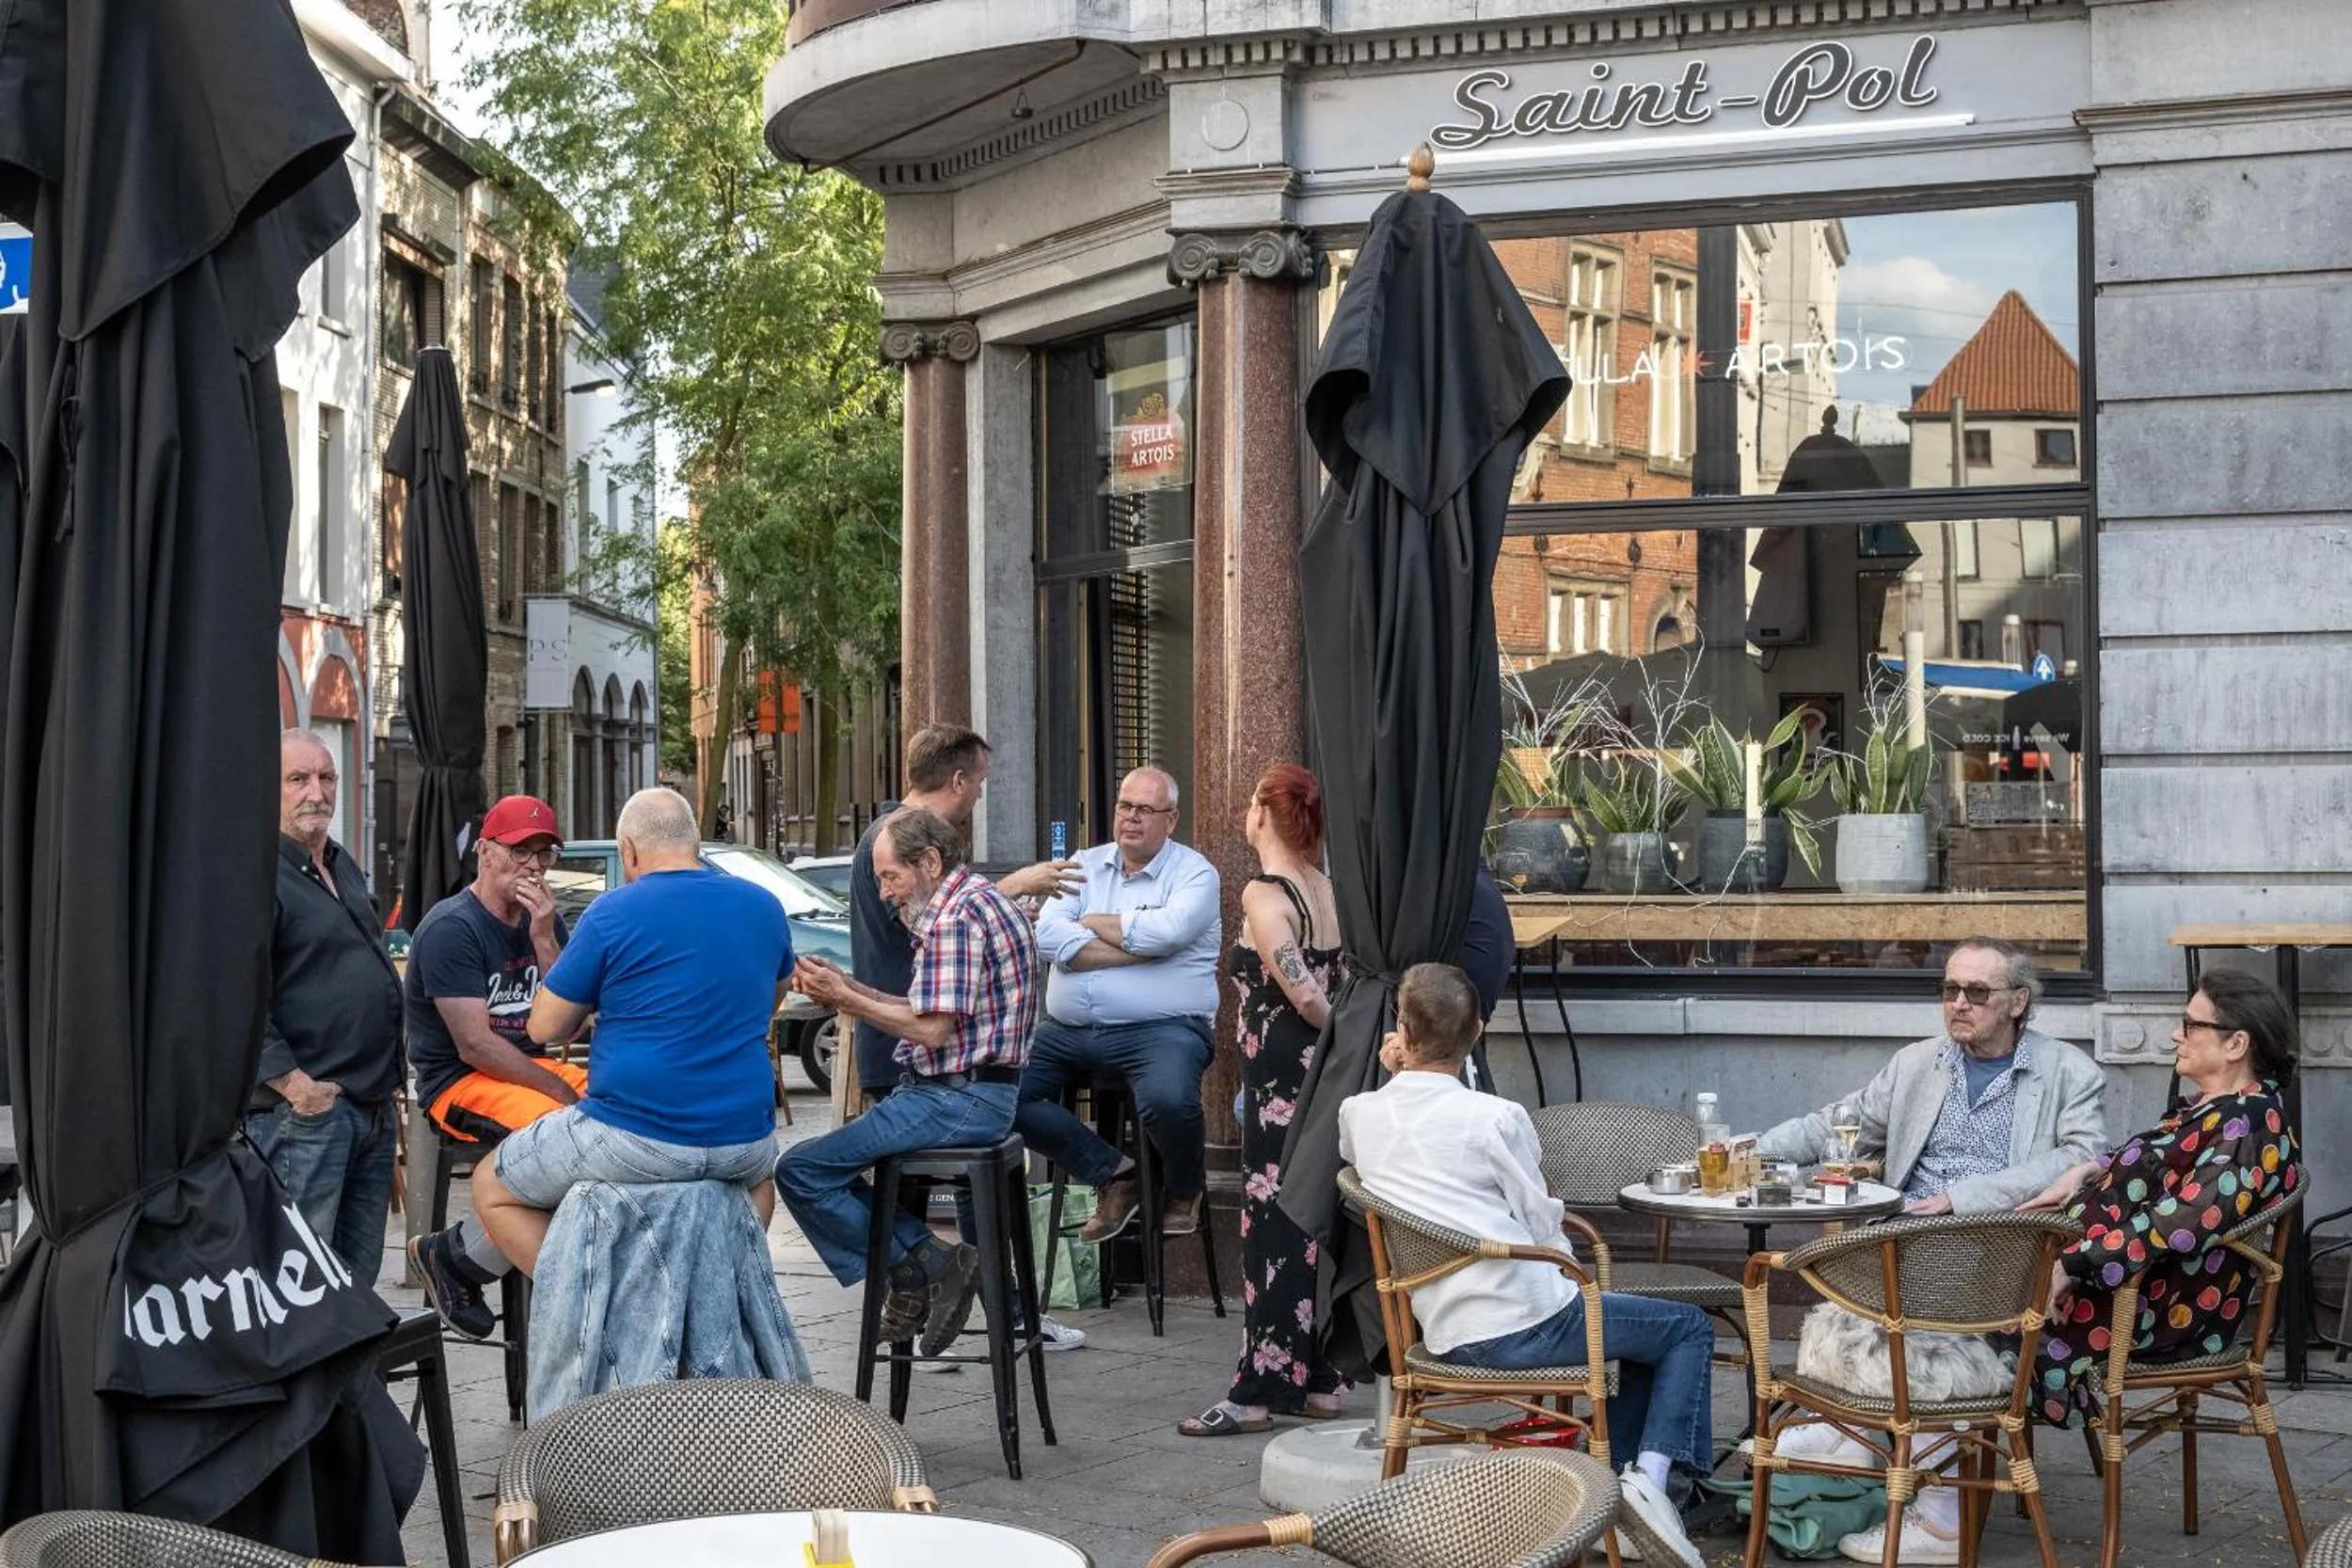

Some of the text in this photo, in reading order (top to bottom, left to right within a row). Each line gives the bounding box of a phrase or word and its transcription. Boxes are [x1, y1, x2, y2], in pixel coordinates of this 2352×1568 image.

[1430, 35, 1938, 150] Saint-Pol
[1724, 336, 1907, 379] ARTOIS
[1131, 425, 1173, 448] STELLA
[1131, 443, 1175, 467] ARTOIS
[124, 1201, 352, 1349] armel
